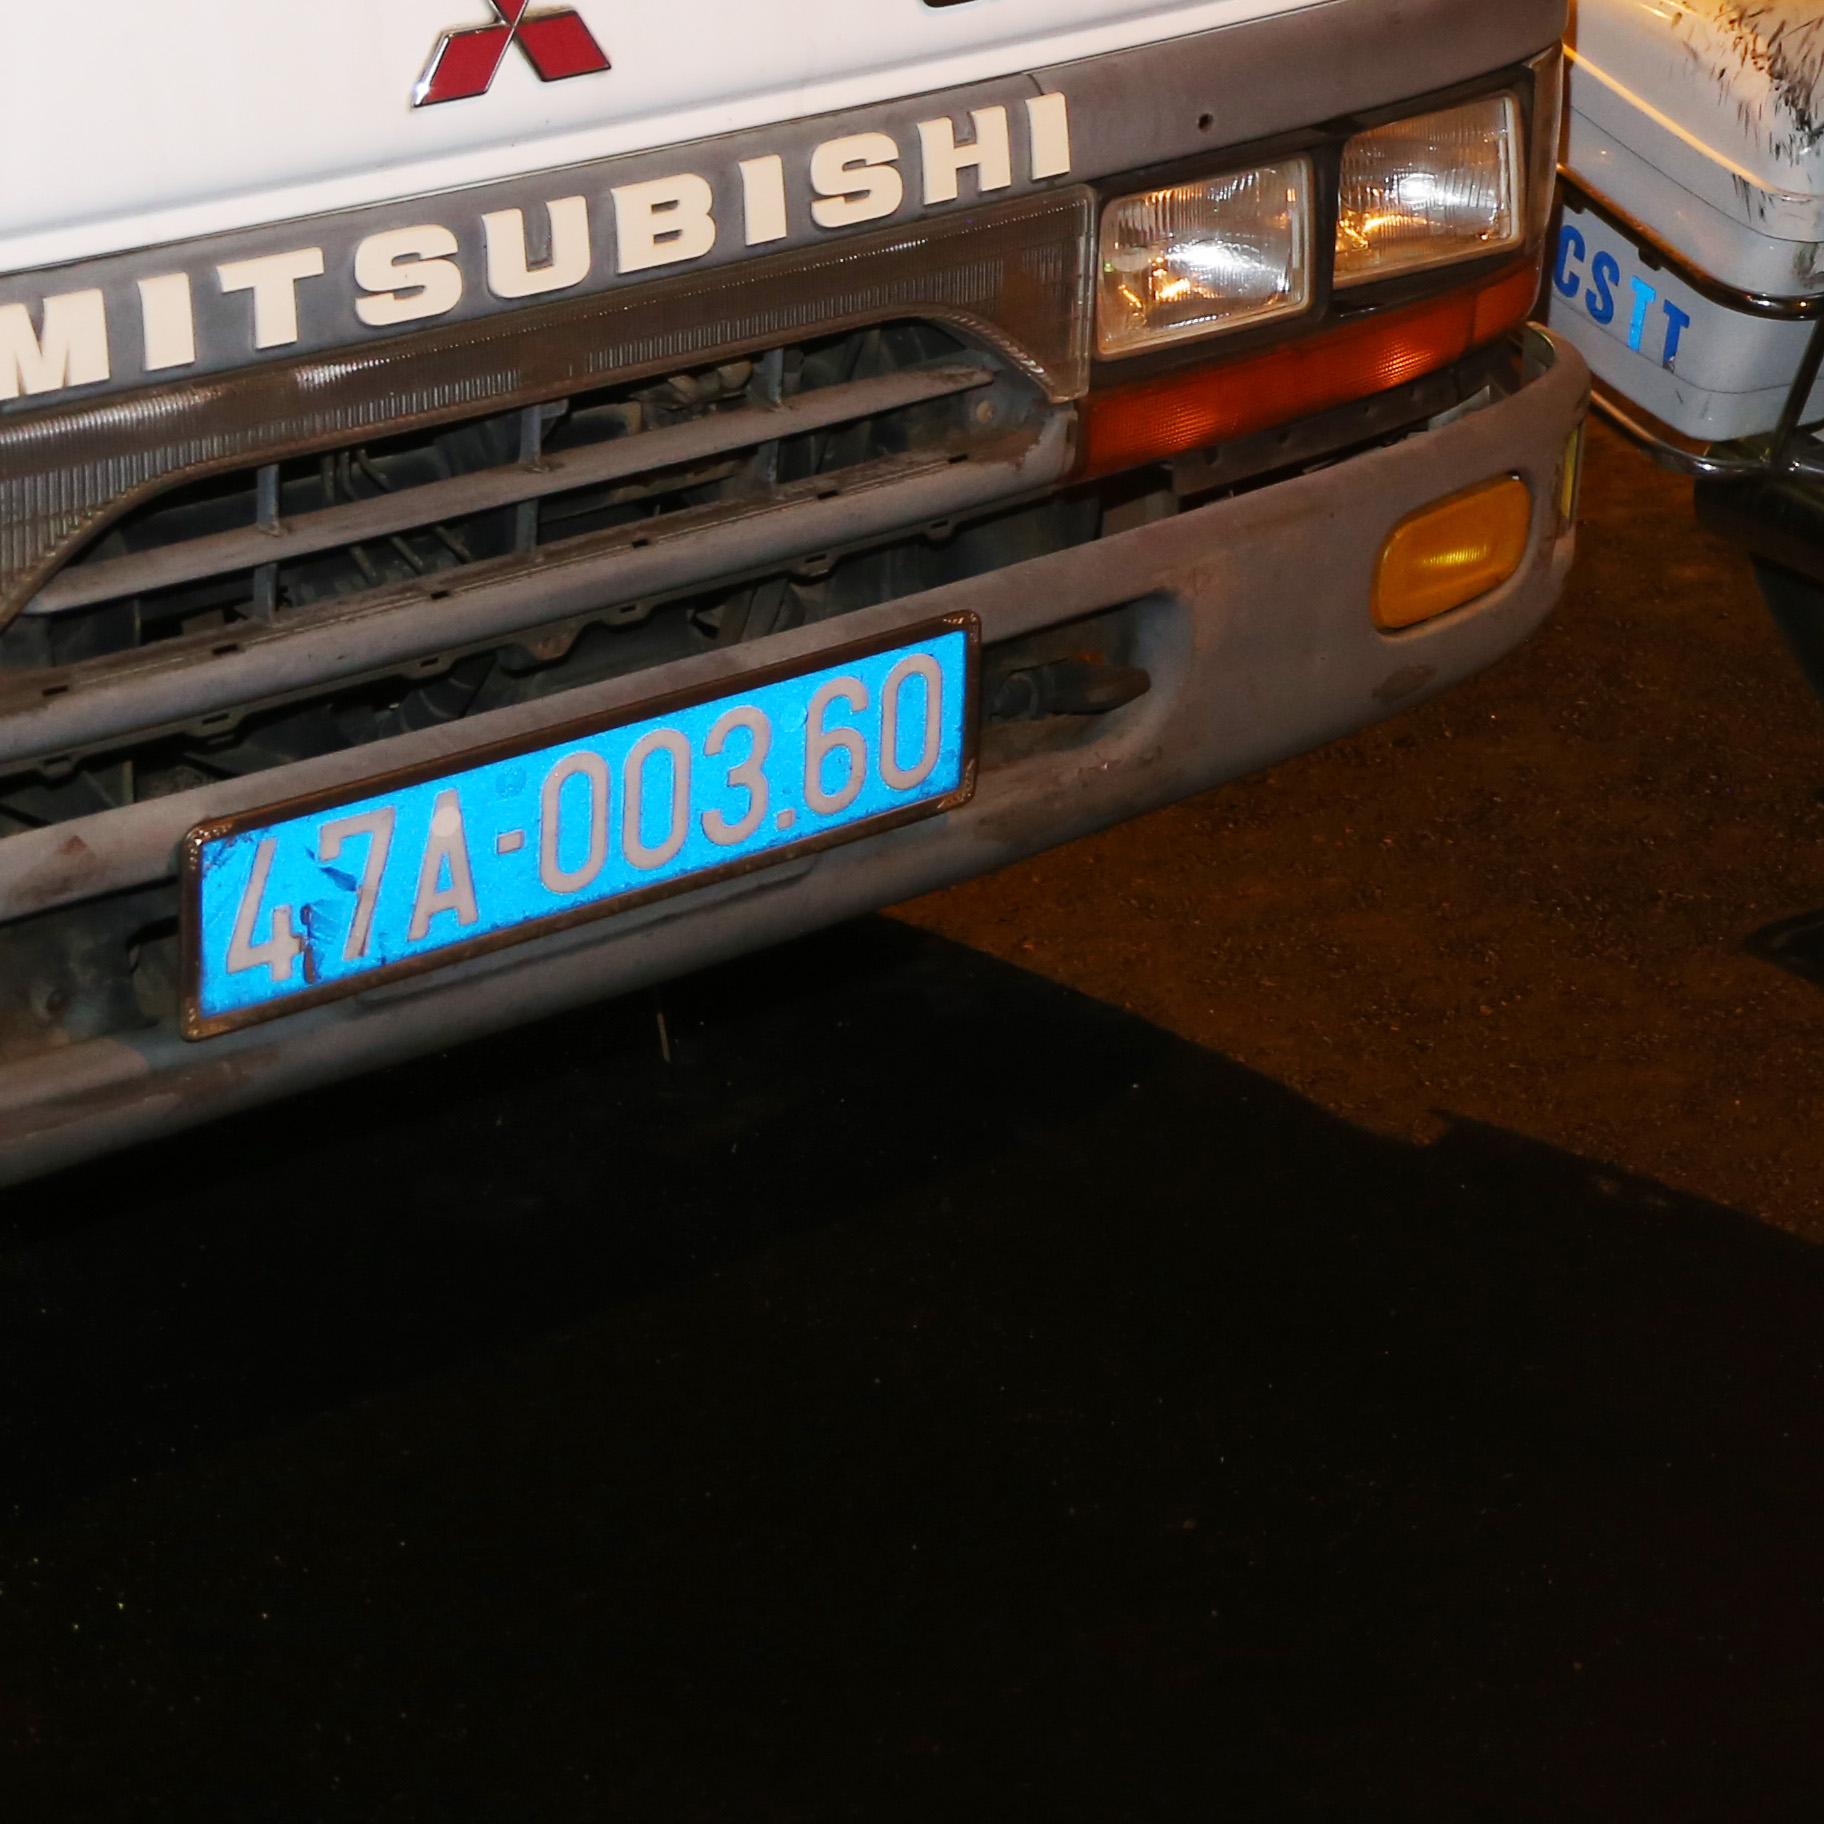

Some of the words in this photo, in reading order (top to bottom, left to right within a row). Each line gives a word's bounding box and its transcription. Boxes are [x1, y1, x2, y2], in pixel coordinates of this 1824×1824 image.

[0, 93, 1072, 400] MITSUBISHI
[1552, 224, 1691, 370] CSTT
[225, 653, 943, 982] 47A-003.60
